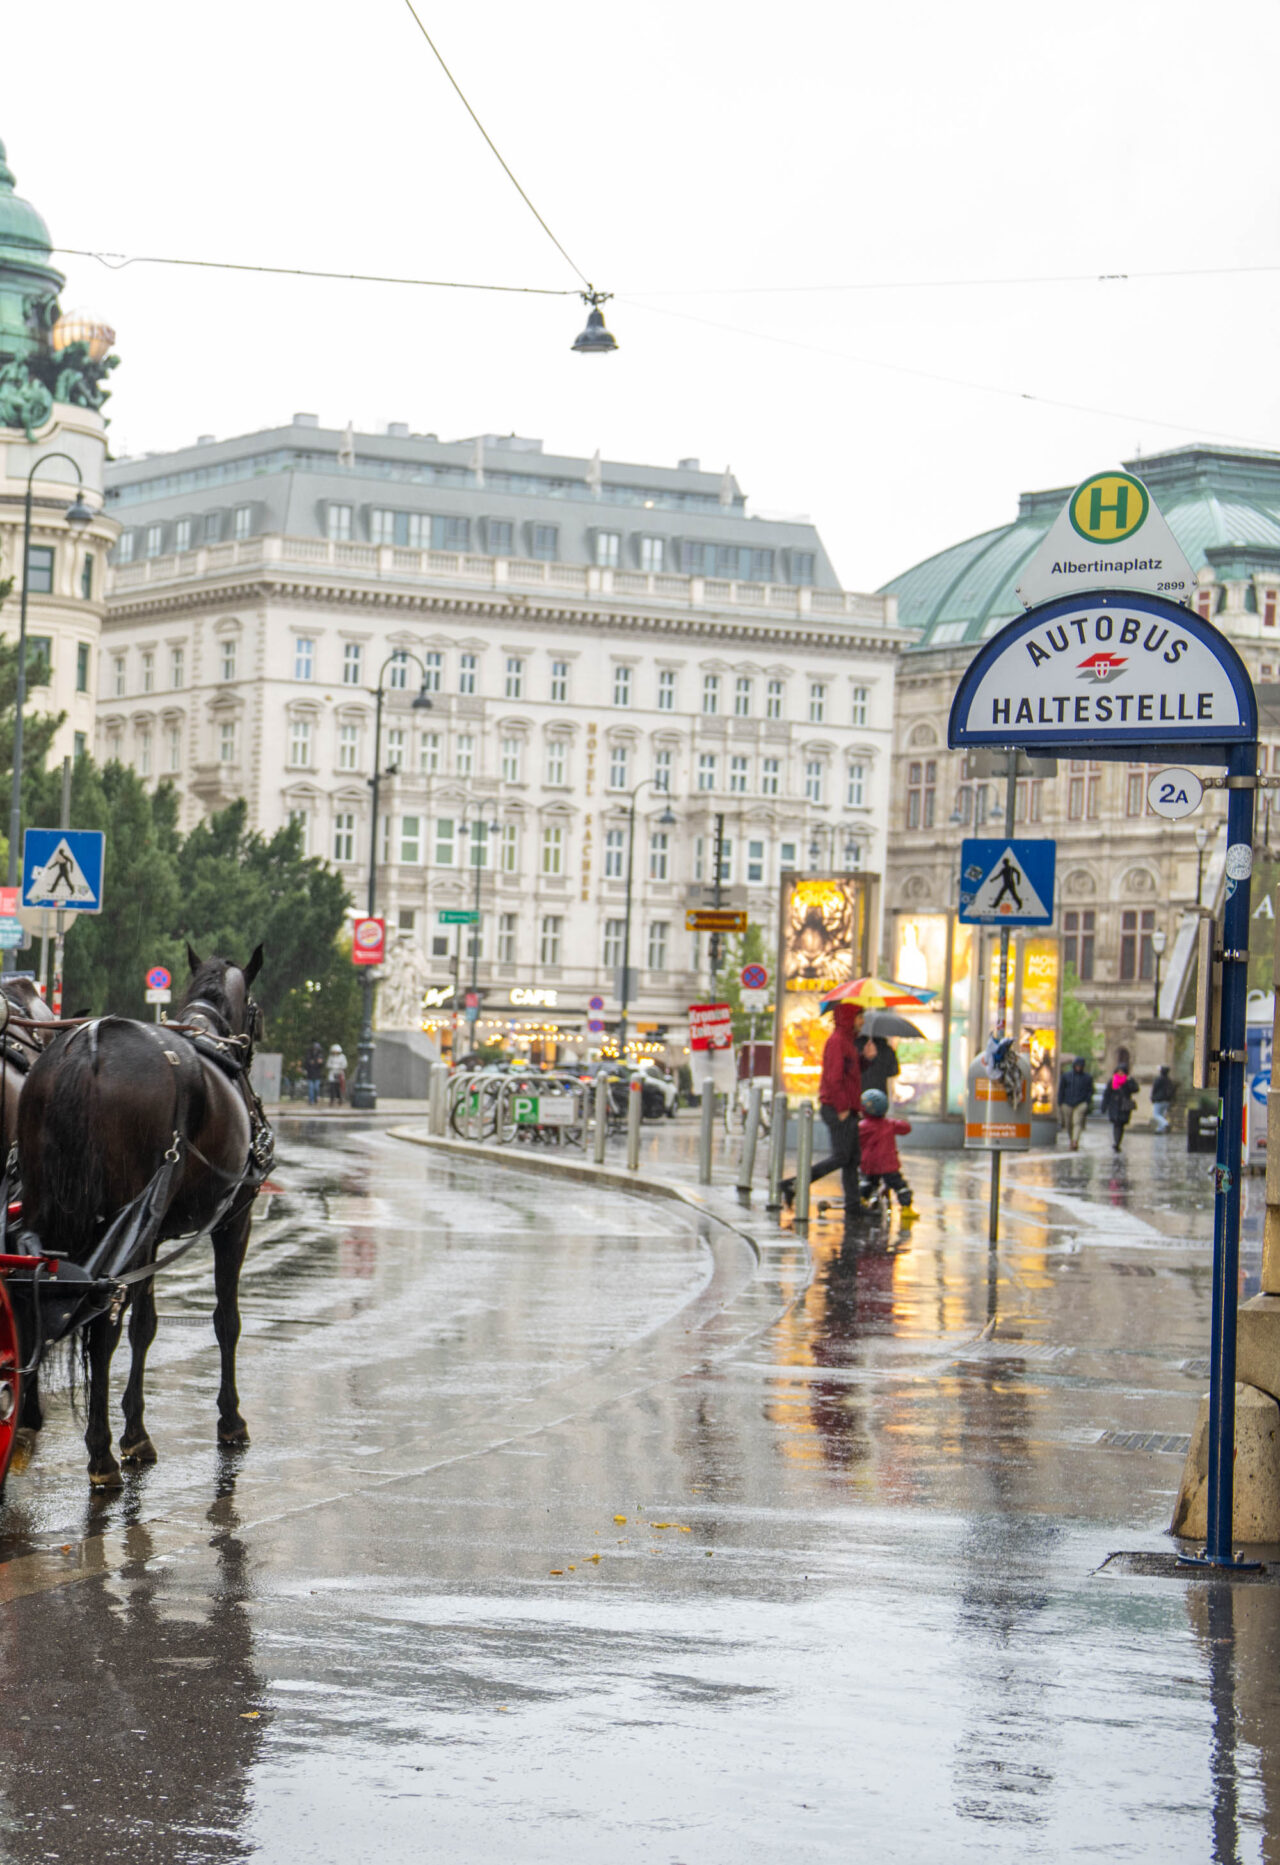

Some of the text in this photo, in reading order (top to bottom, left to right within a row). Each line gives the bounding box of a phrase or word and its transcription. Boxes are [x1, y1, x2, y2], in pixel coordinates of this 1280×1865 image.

[1089, 485, 1129, 531] H
[1051, 558, 1163, 575] Albertinaplatz
[1157, 581, 1185, 591] 2899
[1025, 615, 1188, 667] AUTOBUS
[992, 692, 1214, 725] HALTESTELLE
[1159, 783, 1189, 804] 2A
[581, 722, 597, 902] HOTEL SACHER
[514, 1098, 533, 1121] P
